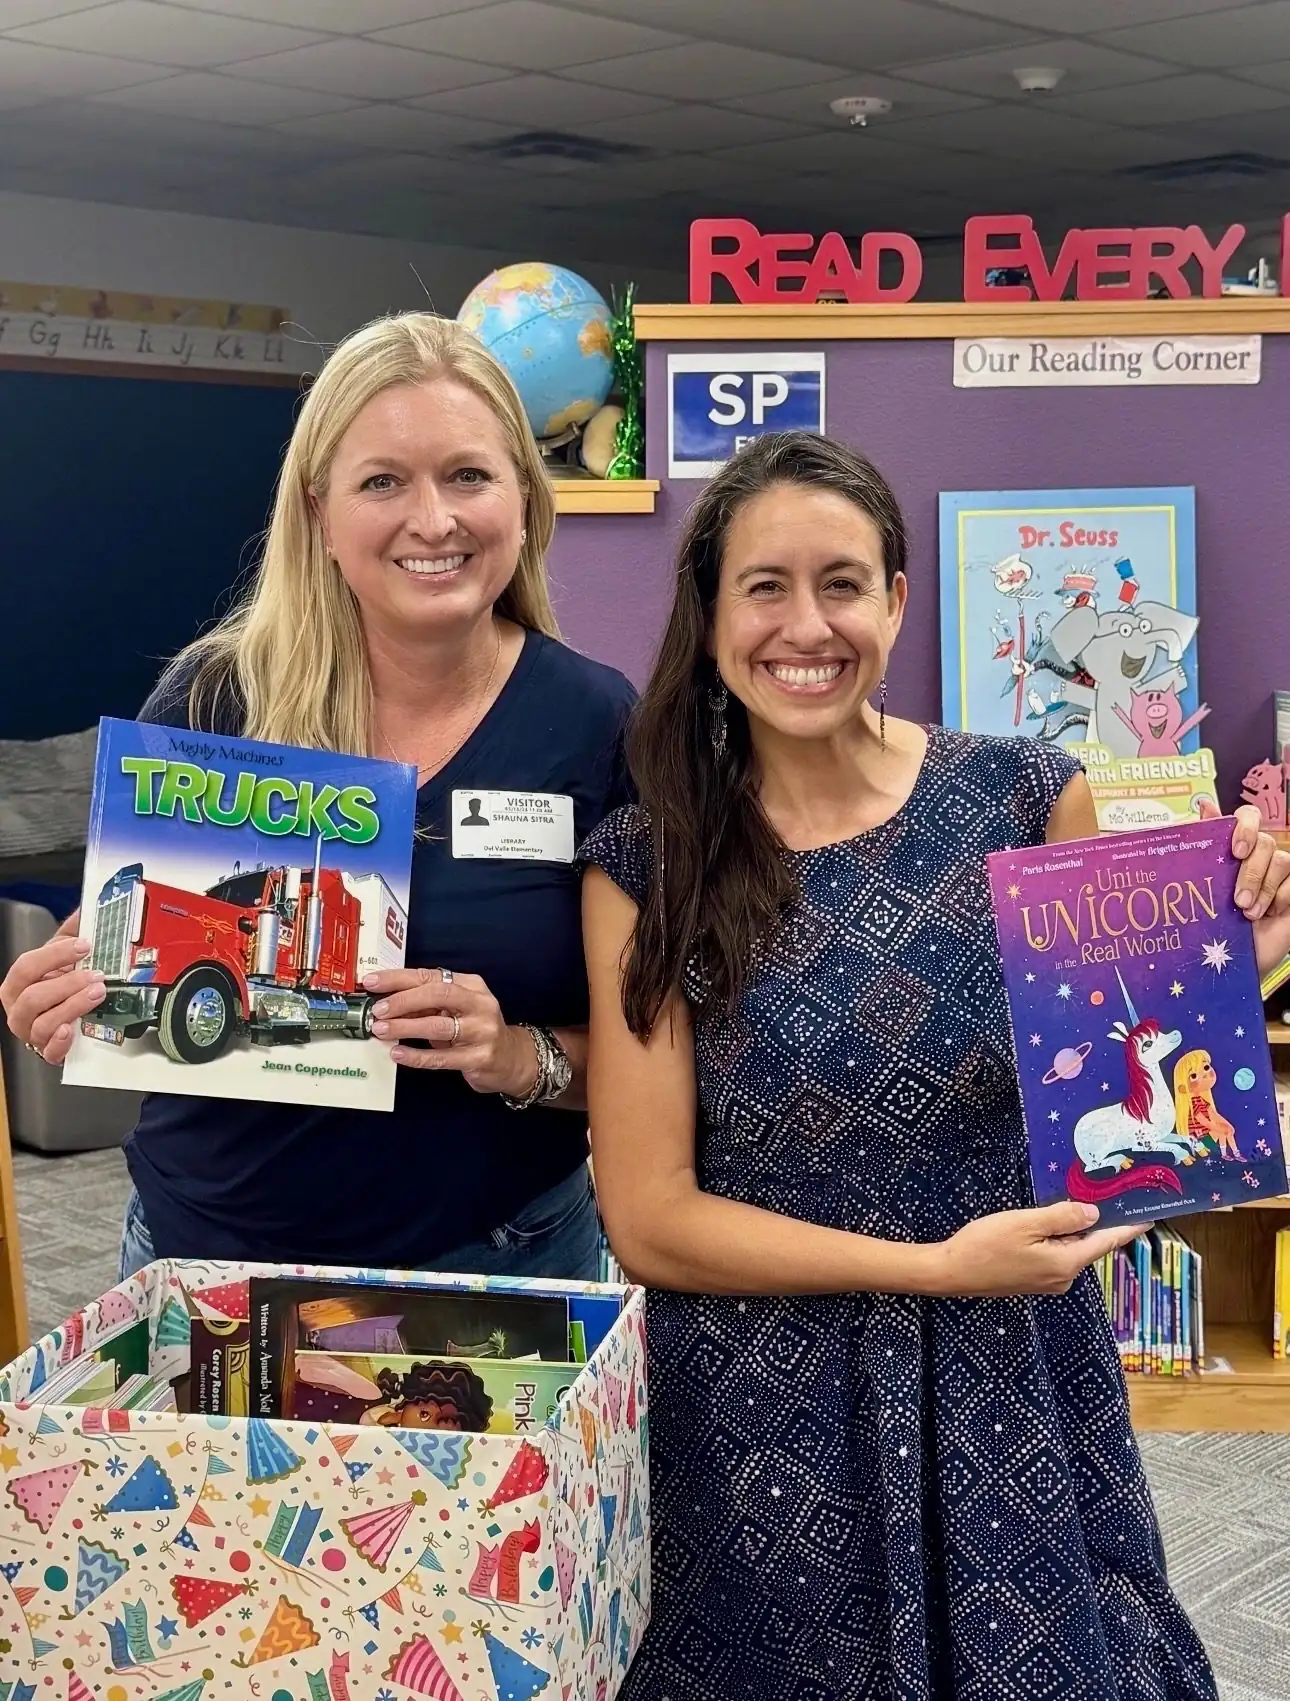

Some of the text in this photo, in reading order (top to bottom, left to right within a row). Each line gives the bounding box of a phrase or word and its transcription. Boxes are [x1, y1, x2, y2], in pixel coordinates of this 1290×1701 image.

[690, 218, 923, 304] READ
[963, 214, 1246, 301] EVERY
[29, 320, 60, 356] Gg
[83, 323, 115, 351] Hh
[962, 341, 1251, 378] Our Reading Corner
[708, 373, 789, 427] SP
[1019, 520, 1119, 549] Dr. Seuss
[219, 746, 284, 766] Machines
[1120, 754, 1210, 782] FRIENDS!
[121, 757, 380, 843] TRUCKS
[507, 797, 550, 808] VISITOR
[492, 814, 554, 824] SHAUNA SITRA
[1125, 810, 1170, 823] Willems
[1022, 858, 1084, 876] Paris Rosenthal
[1096, 865, 1157, 892] Uni the
[1055, 928, 1182, 970] in the Real World
[262, 1060, 368, 1078] Jean Coppendale
[260, 1303, 270, 1336] Written
[209, 1348, 222, 1412] Corey Rosen
[260, 1351, 273, 1390] Amanda
[260, 1393, 273, 1413] Noll
[515, 1383, 536, 1430] Pink
